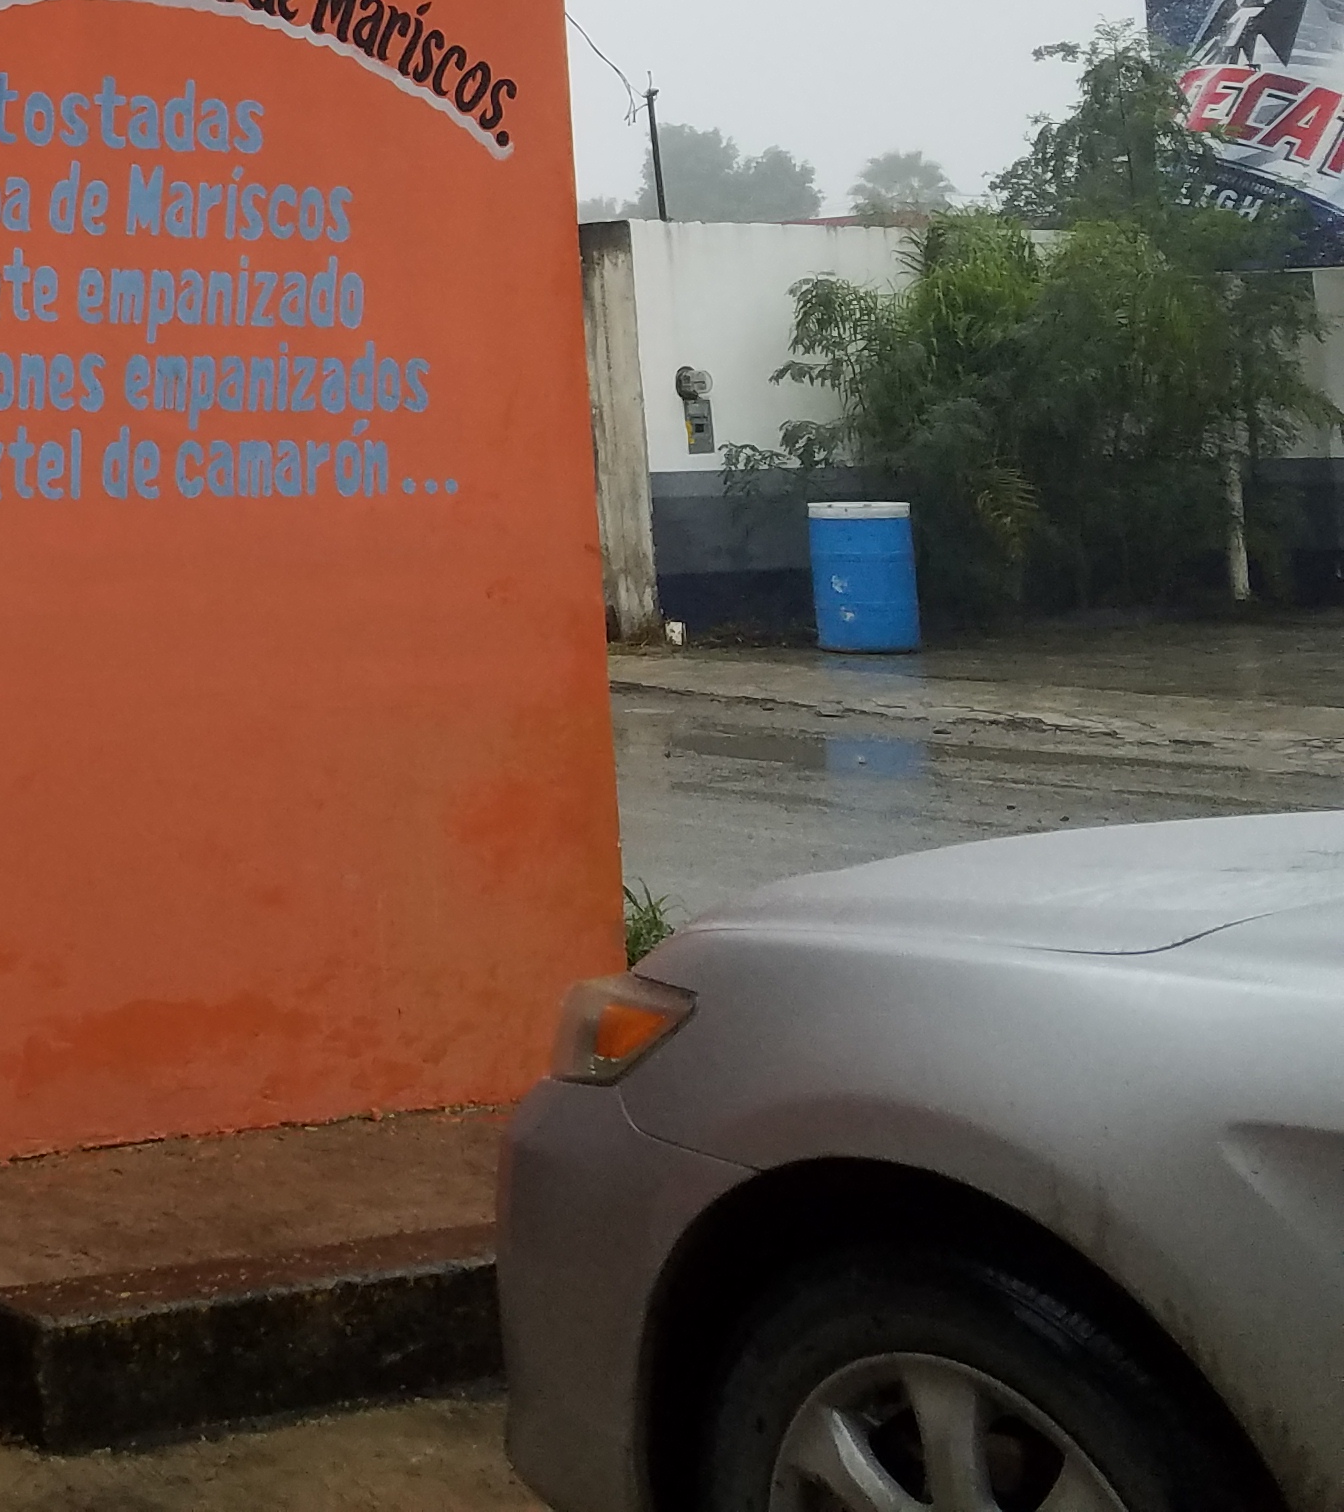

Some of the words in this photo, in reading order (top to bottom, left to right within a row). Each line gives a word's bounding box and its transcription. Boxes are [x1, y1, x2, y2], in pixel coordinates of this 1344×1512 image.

[1178, 67, 1344, 175] ECA
[49, 160, 109, 235] de
[77, 255, 365, 344] empanizado
[124, 340, 430, 431] empanizados
[102, 426, 161, 500] de
